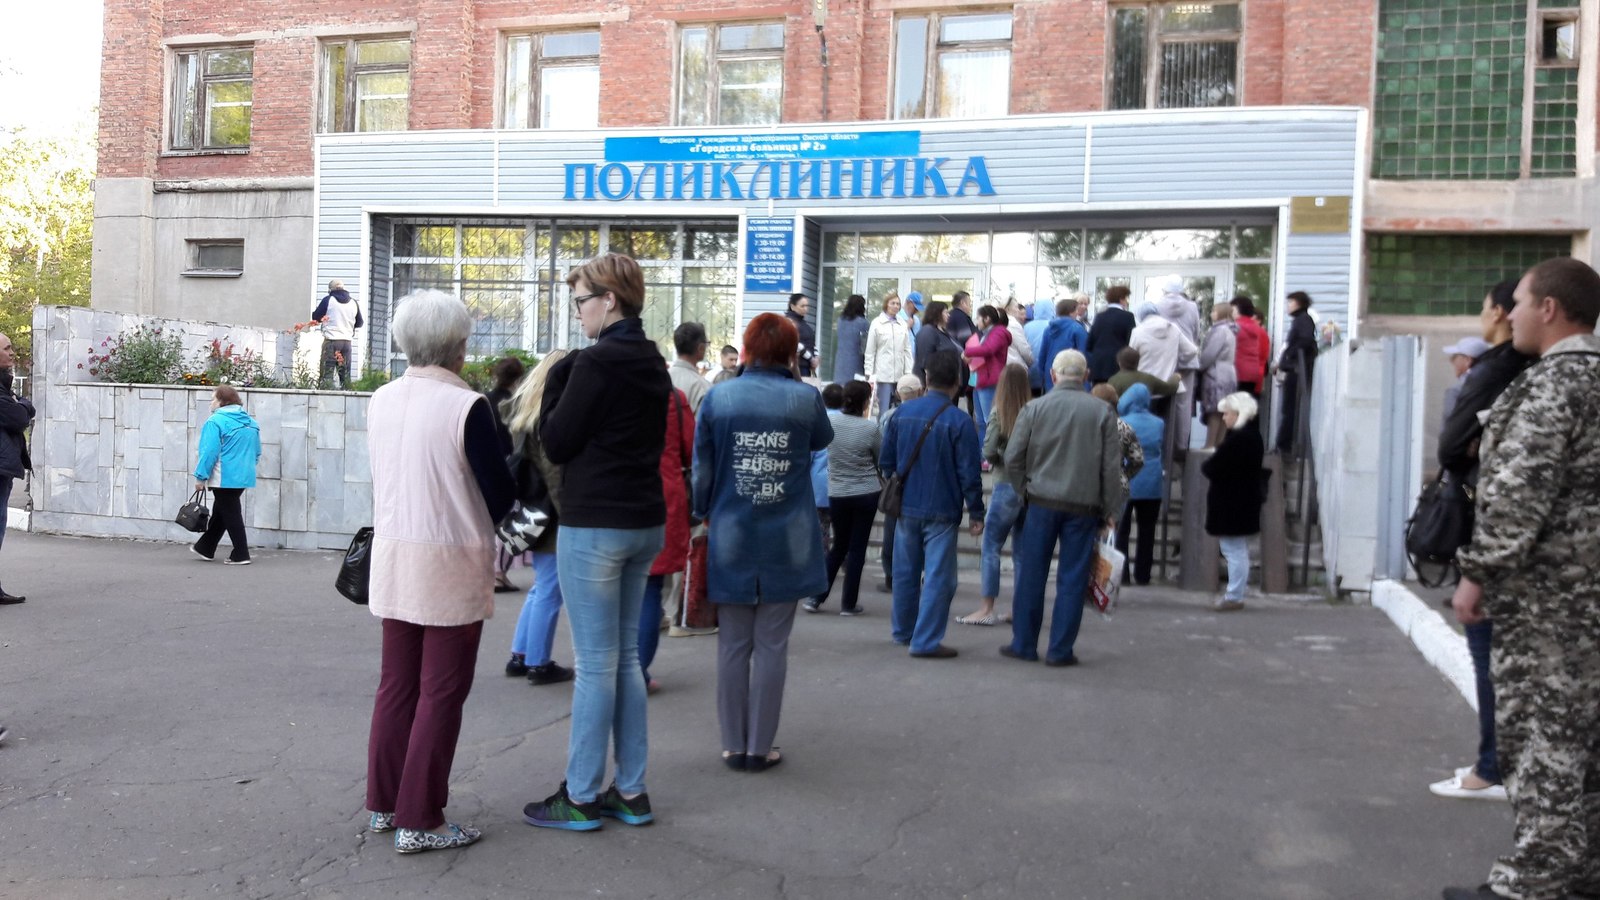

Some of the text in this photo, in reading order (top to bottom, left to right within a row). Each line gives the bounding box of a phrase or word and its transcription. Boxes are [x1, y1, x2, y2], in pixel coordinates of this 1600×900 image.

[689, 144, 748, 154] «Городская
[750, 142, 799, 152] больница
[800, 142, 811, 151] №
[563, 157, 998, 201] ПОЛИКЛИНИКА
[735, 432, 789, 448] JEANS
[761, 482, 785, 496] BK
